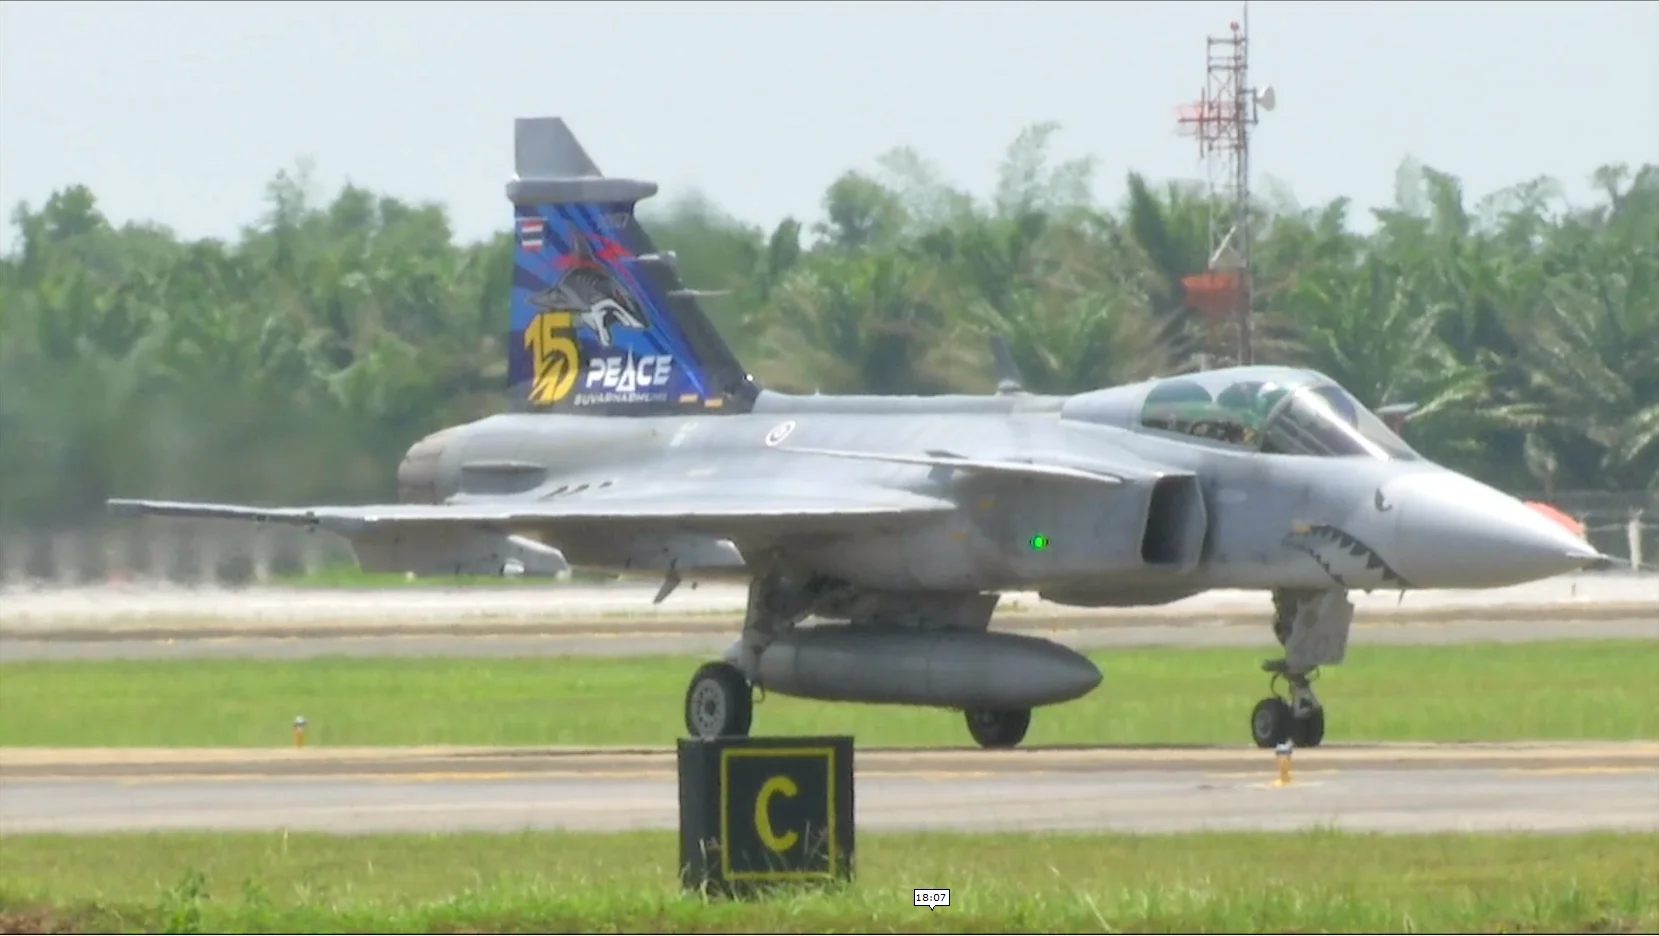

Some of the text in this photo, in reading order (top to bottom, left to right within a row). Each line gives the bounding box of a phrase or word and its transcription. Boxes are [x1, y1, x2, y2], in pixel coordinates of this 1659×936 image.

[524, 311, 580, 405] 15
[585, 346, 673, 392] PEACE
[754, 775, 799, 852] C
